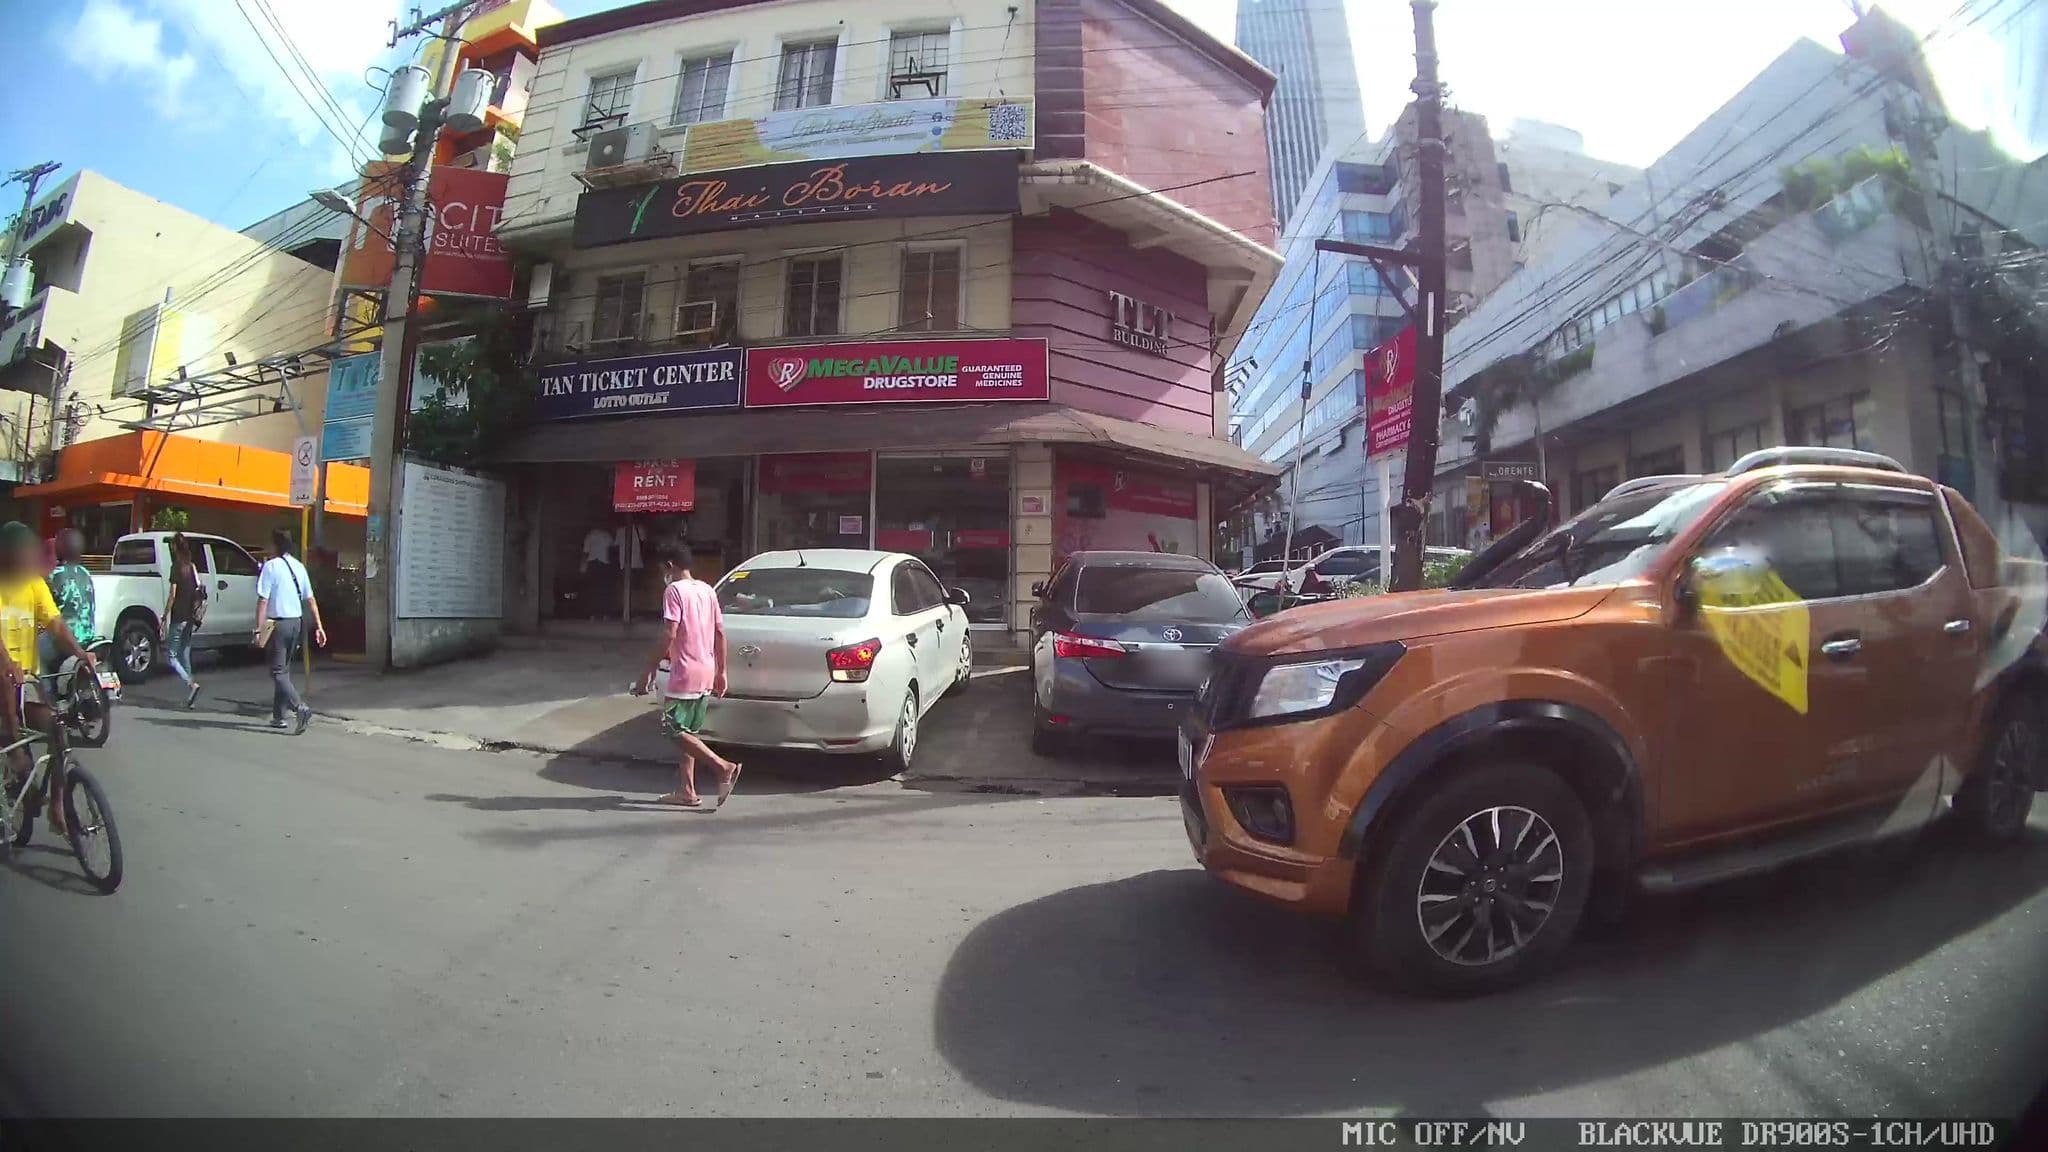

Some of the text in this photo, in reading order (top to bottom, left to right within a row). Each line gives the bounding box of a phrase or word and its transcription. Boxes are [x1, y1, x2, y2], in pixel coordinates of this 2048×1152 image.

[672, 163, 952, 218] Thai Boran
[440, 201, 503, 233] CIT
[1109, 290, 1176, 341] TLT
[1113, 327, 1170, 356] BUILDING
[961, 364, 1023, 373] GUARANTEED
[982, 372, 1023, 380] GENUINE
[541, 361, 735, 397] TAN TICKET CENTER
[863, 374, 958, 390] DRUGSTORE
[975, 379, 1024, 387] MEDICINES
[593, 391, 670, 409] LOTTO OUTLET
[633, 475, 678, 488] RENT
